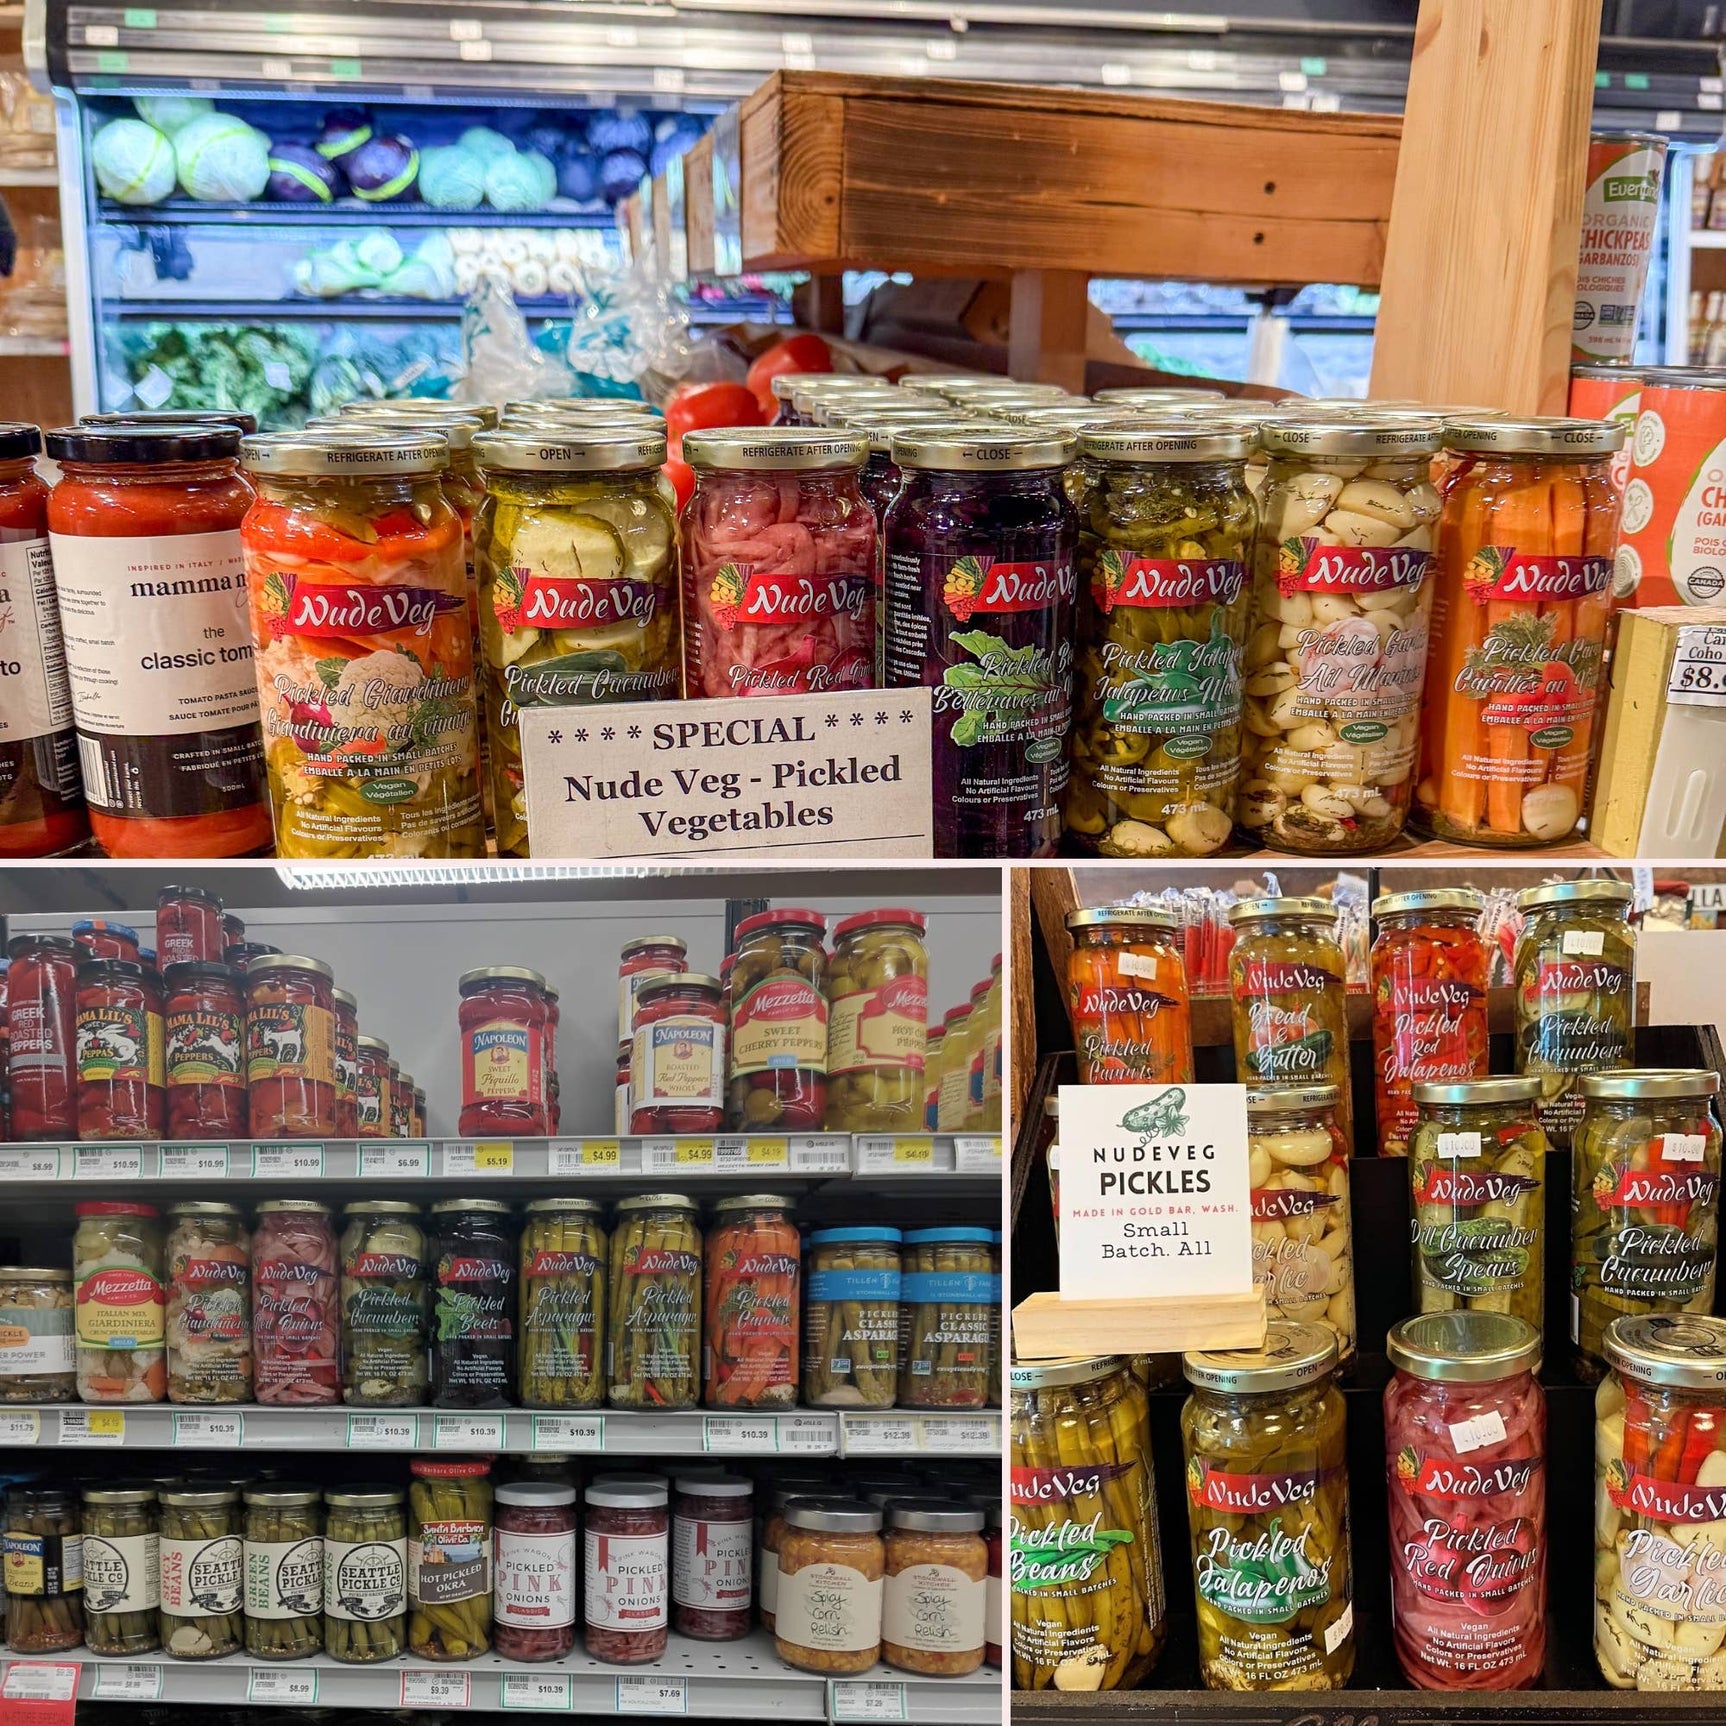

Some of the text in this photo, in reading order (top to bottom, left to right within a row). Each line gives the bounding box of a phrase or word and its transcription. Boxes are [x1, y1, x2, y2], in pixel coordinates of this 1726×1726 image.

[1282, 432, 1309, 444] CLOSE
[1564, 432, 1595, 444] CLOSE
[742, 445, 831, 457] REFRIGERATE AFTER
[1125, 439, 1197, 451] AFTER OPENING
[327, 450, 422, 463] REFRIGERATE AFTER
[539, 448, 572, 461] OPEN
[976, 448, 1011, 461] CLOSE
[131, 577, 232, 597] mamma
[1689, 578, 1724, 586] CANADA
[203, 627, 225, 639] the
[1297, 629, 1380, 657] Pickled
[1482, 636, 1566, 663] Pickled
[141, 649, 215, 670] classic
[1102, 642, 1181, 670] Pickled
[1688, 647, 1722, 660] Coho
[504, 664, 580, 696] Pickled
[729, 663, 799, 690] Pickled
[274, 674, 354, 704] Pickled
[179, 692, 238, 705] TOMATO PASTA
[169, 706, 249, 721] SAUCE TOMATE POUR
[1120, 712, 1180, 721] HAND PACKED
[653, 716, 815, 750] SPECIAL
[307, 751, 421, 763] HAND PACKED SMALL
[374, 766, 400, 776] MAIN
[564, 754, 902, 802] Nude Veg Pickled
[973, 777, 1000, 786] Natural
[373, 782, 406, 790] Vegan
[966, 783, 1039, 795] No Artificial Flavours
[952, 792, 1039, 804] Colours Preservatives
[1024, 808, 1044, 822] 473
[1161, 803, 1187, 815] 473
[334, 815, 381, 824] Ingredients
[639, 802, 834, 841] Vegetables
[344, 824, 382, 832] Flavours
[164, 939, 194, 948] GREEK
[750, 990, 816, 1014] Mezzetta
[11, 1008, 45, 1019] GREEK
[1249, 1002, 1312, 1027] Bread
[19, 1019, 34, 1028] RED
[1395, 1012, 1463, 1040] Pickled
[10, 1029, 53, 1039] ROASTED
[655, 1029, 712, 1042] NAPOLEON
[763, 1026, 801, 1037] SWEET
[10, 1040, 53, 1051] PEPPERS
[473, 1032, 527, 1050] NAPOLEON
[738, 1040, 779, 1053] CHERRY
[1411, 1039, 1439, 1056] Red
[83, 1049, 114, 1058] PEPPAS
[175, 1053, 214, 1061] PEPPERS
[1256, 1046, 1317, 1073] Butter
[481, 1073, 520, 1086] Piquillo
[593, 1151, 617, 1161] $4.99
[688, 1150, 712, 1160] $4.99
[1094, 1145, 1215, 1163] NUDEVEG
[113, 1159, 138, 1169] $10.99
[199, 1159, 224, 1169] $10.99
[294, 1158, 320, 1168] $10.99
[398, 1158, 420, 1167] $6.99
[486, 1156, 508, 1166] $5.19
[1101, 1170, 1210, 1195] PICKLES
[1073, 1209, 1105, 1218] MADE
[1130, 1207, 1162, 1215] GOLD
[1169, 1206, 1195, 1215] BAR,
[1202, 1204, 1239, 1213] WASH.
[1124, 1222, 1189, 1238] Small
[1618, 1228, 1703, 1257] Pickled
[1102, 1241, 1212, 1259] Batch. All
[1442, 1252, 1519, 1282] Spears
[90, 1278, 151, 1295] Mezzetta
[1604, 1286, 1656, 1296] HAND PACKED
[88, 1318, 156, 1328] GIARDINIERA
[18, 1351, 46, 1359] POWER
[209, 1424, 235, 1433] $10.39
[384, 1427, 410, 1436] $10.39
[470, 1427, 496, 1436] $10.39
[570, 1428, 596, 1437] $10.39
[741, 1430, 768, 1439] $10.39
[1208, 1522, 1310, 1558] Pickled
[1423, 1517, 1521, 1553] Pickled
[506, 1561, 555, 1572] PICKLED
[1404, 1542, 1456, 1581] Red
[341, 1564, 400, 1578] SEATTLE
[420, 1564, 482, 1584] HOT PICKLED
[618, 1565, 663, 1574] PICKLED
[162, 1554, 170, 1601] SPICY
[170, 1551, 183, 1606] BEANS
[249, 1553, 257, 1608] GREEN
[258, 1554, 270, 1609] BEANS
[341, 1577, 388, 1589] PICKLE
[498, 1574, 562, 1593] PINK
[1196, 1555, 1332, 1602] Jalapenos
[436, 1580, 466, 1593] OKRA
[506, 1595, 550, 1604] ONIONS
[618, 1596, 661, 1606] ONIONS
[810, 1591, 847, 1610] Spicy
[810, 1623, 849, 1636] Relish
[1427, 1624, 1520, 1640] All Natural Ingredients
[1461, 1622, 1489, 1631] Vegan
[1249, 1632, 1277, 1641] Vegan
[1446, 1636, 1516, 1650] Artificial Flavors
[1426, 1644, 1523, 1659] Colors Preservatives
[1420, 1652, 1435, 1663] Net
[1468, 1662, 1481, 1670] FL
[1482, 1660, 1496, 1669] OZ
[1499, 1657, 1514, 1667] 473
[289, 1684, 309, 1692] $8.99
[430, 1686, 449, 1695] $9.39
[538, 1685, 564, 1694] $10.39
[659, 1690, 680, 1698] $7.69
